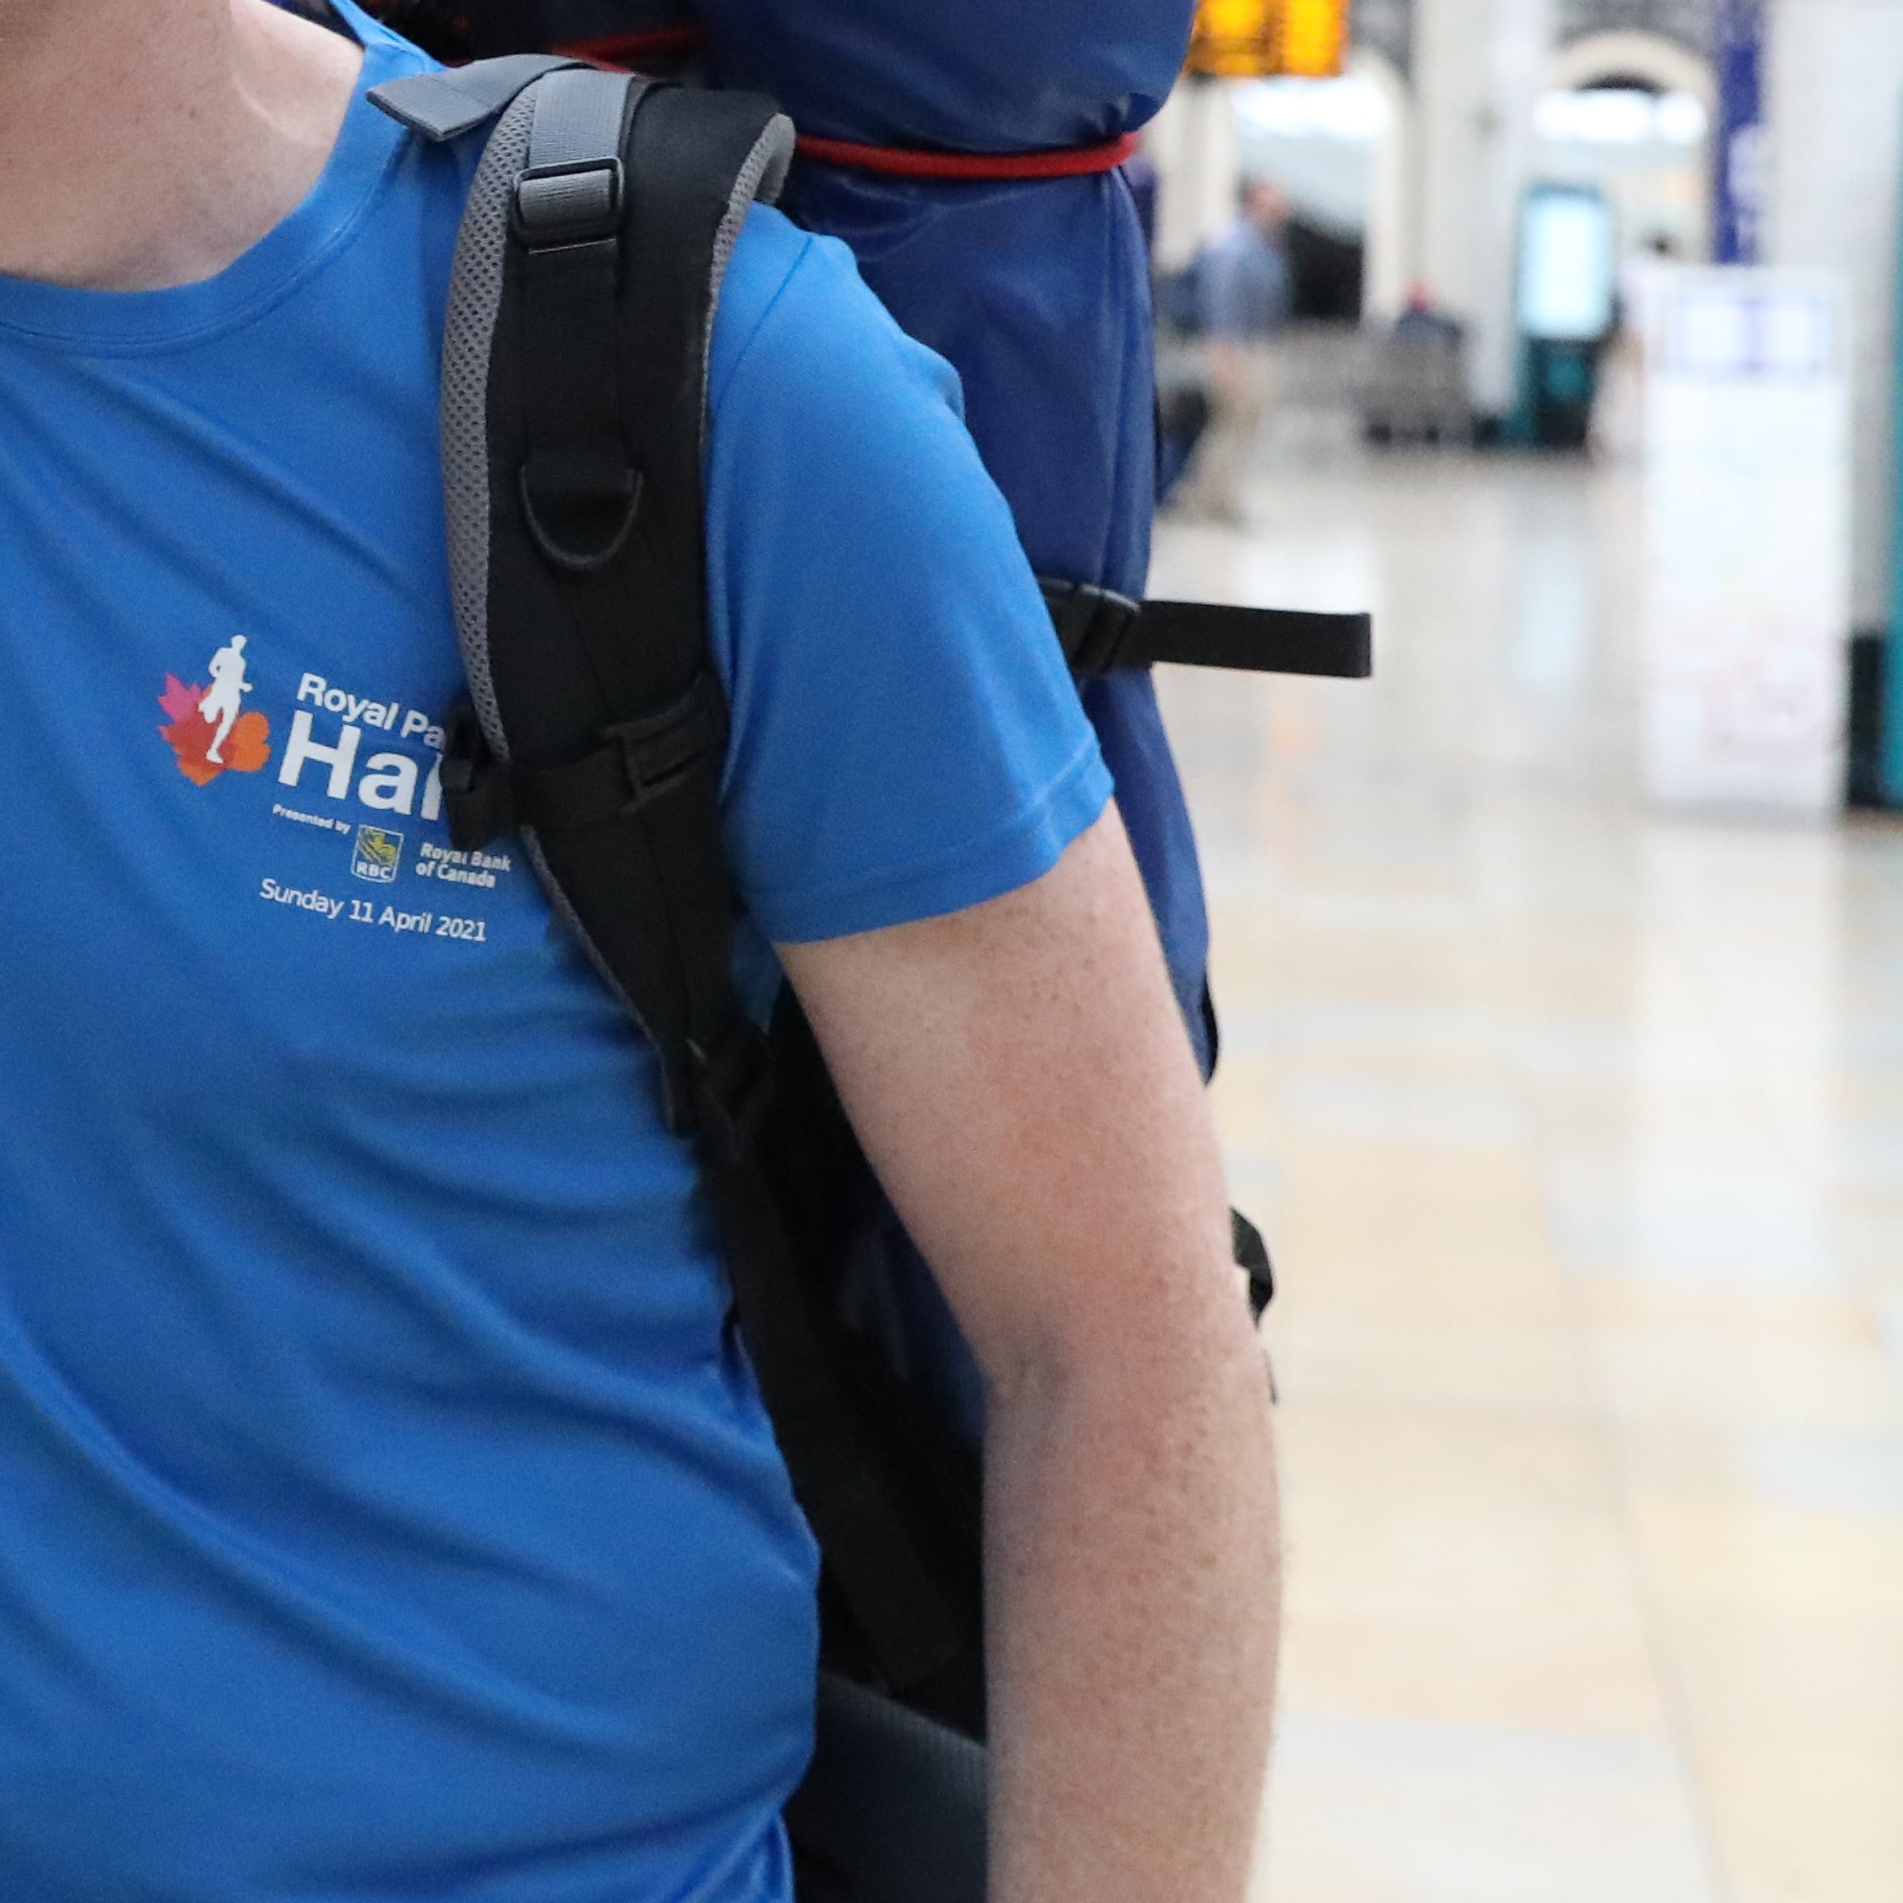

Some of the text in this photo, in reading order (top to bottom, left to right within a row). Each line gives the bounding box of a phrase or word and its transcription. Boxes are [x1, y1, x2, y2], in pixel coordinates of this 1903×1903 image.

[297, 672, 445, 749] Royal Pa
[278, 709, 443, 821] Hal
[273, 803, 351, 835] Presented by
[356, 861, 391, 879] RBC
[420, 842, 511, 872] Royal Bank
[415, 861, 496, 888] of Canada
[259, 878, 487, 942] Sunday 11 April 2021
